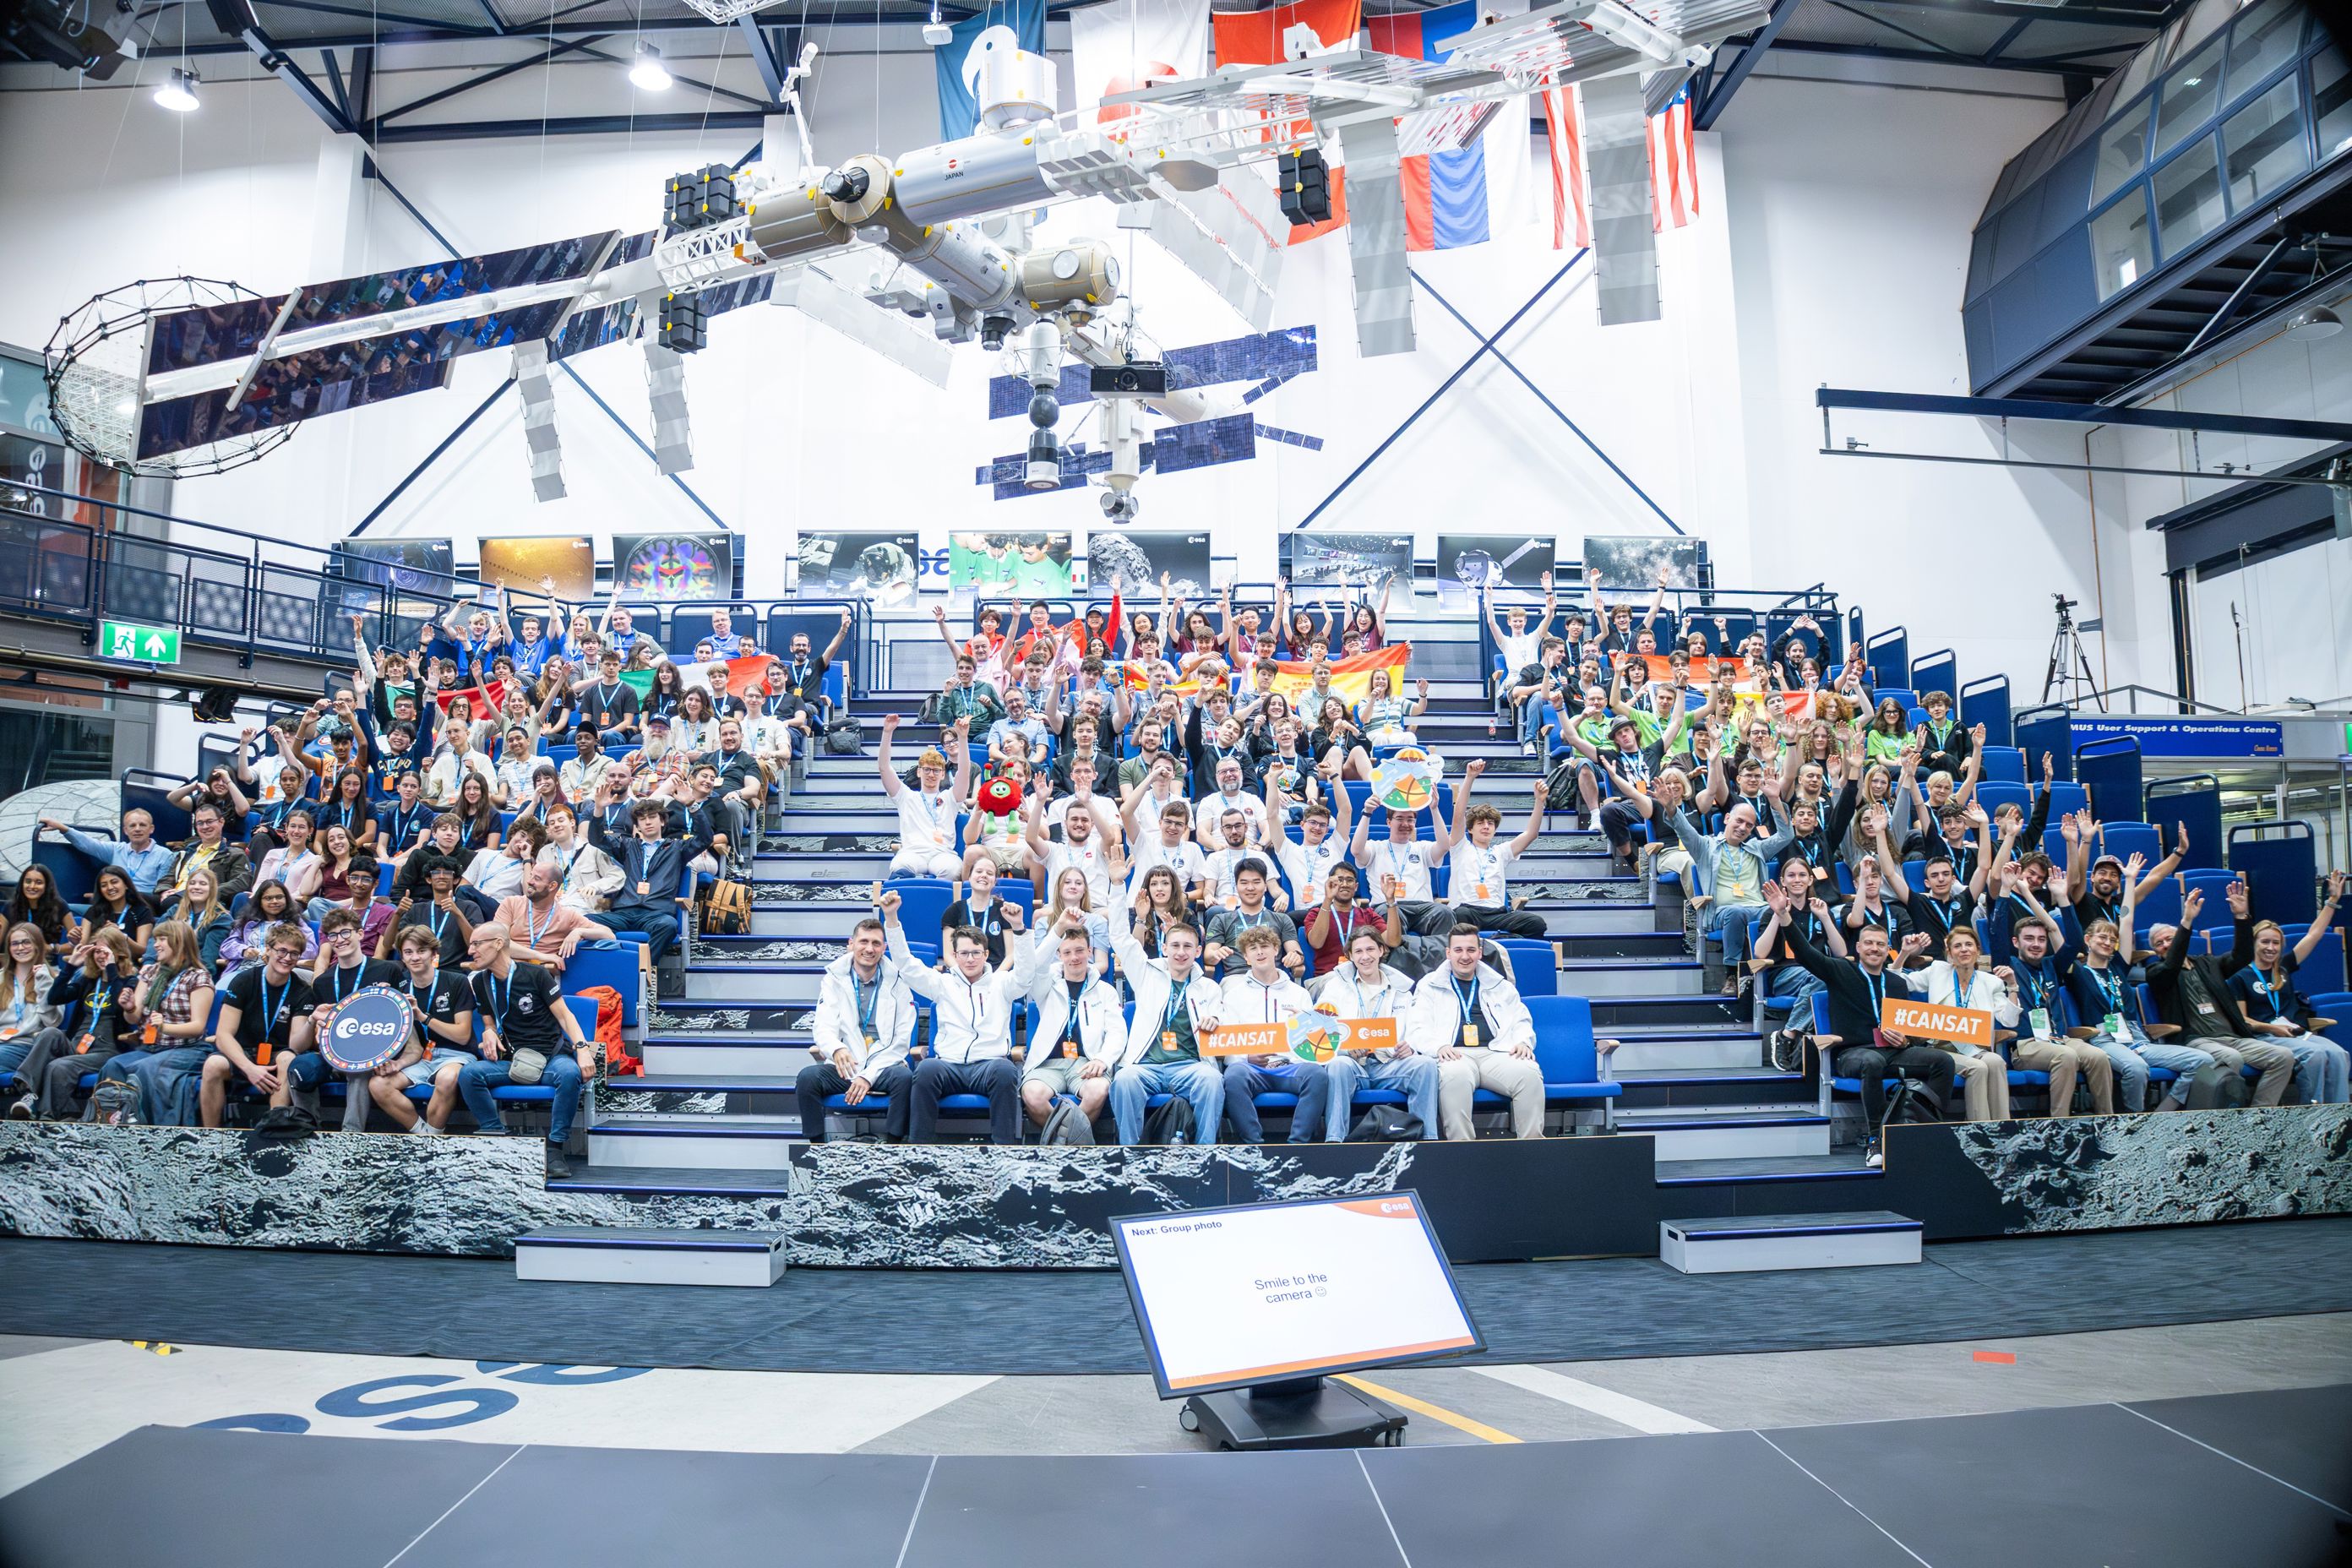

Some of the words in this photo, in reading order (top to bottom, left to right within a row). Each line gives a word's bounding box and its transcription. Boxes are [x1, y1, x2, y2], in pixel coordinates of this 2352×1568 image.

[945, 172, 964, 181] JAPAN
[2124, 725, 2167, 733] Support
[2182, 725, 2240, 735] Operations
[1518, 868, 1556, 877] elan
[359, 1021, 396, 1036] esa
[1894, 1008, 1982, 1036] #CANSAT
[1208, 1030, 1277, 1048] #CANSAT
[1371, 1028, 1391, 1037] esa
[1131, 1228, 1158, 1237] Next:
[1160, 1223, 1192, 1233] Group
[1194, 1221, 1222, 1232] photo
[1255, 1277, 1291, 1290] Smile
[1293, 1276, 1305, 1286] to
[1307, 1273, 1328, 1284] the
[1266, 1290, 1313, 1304] camera
